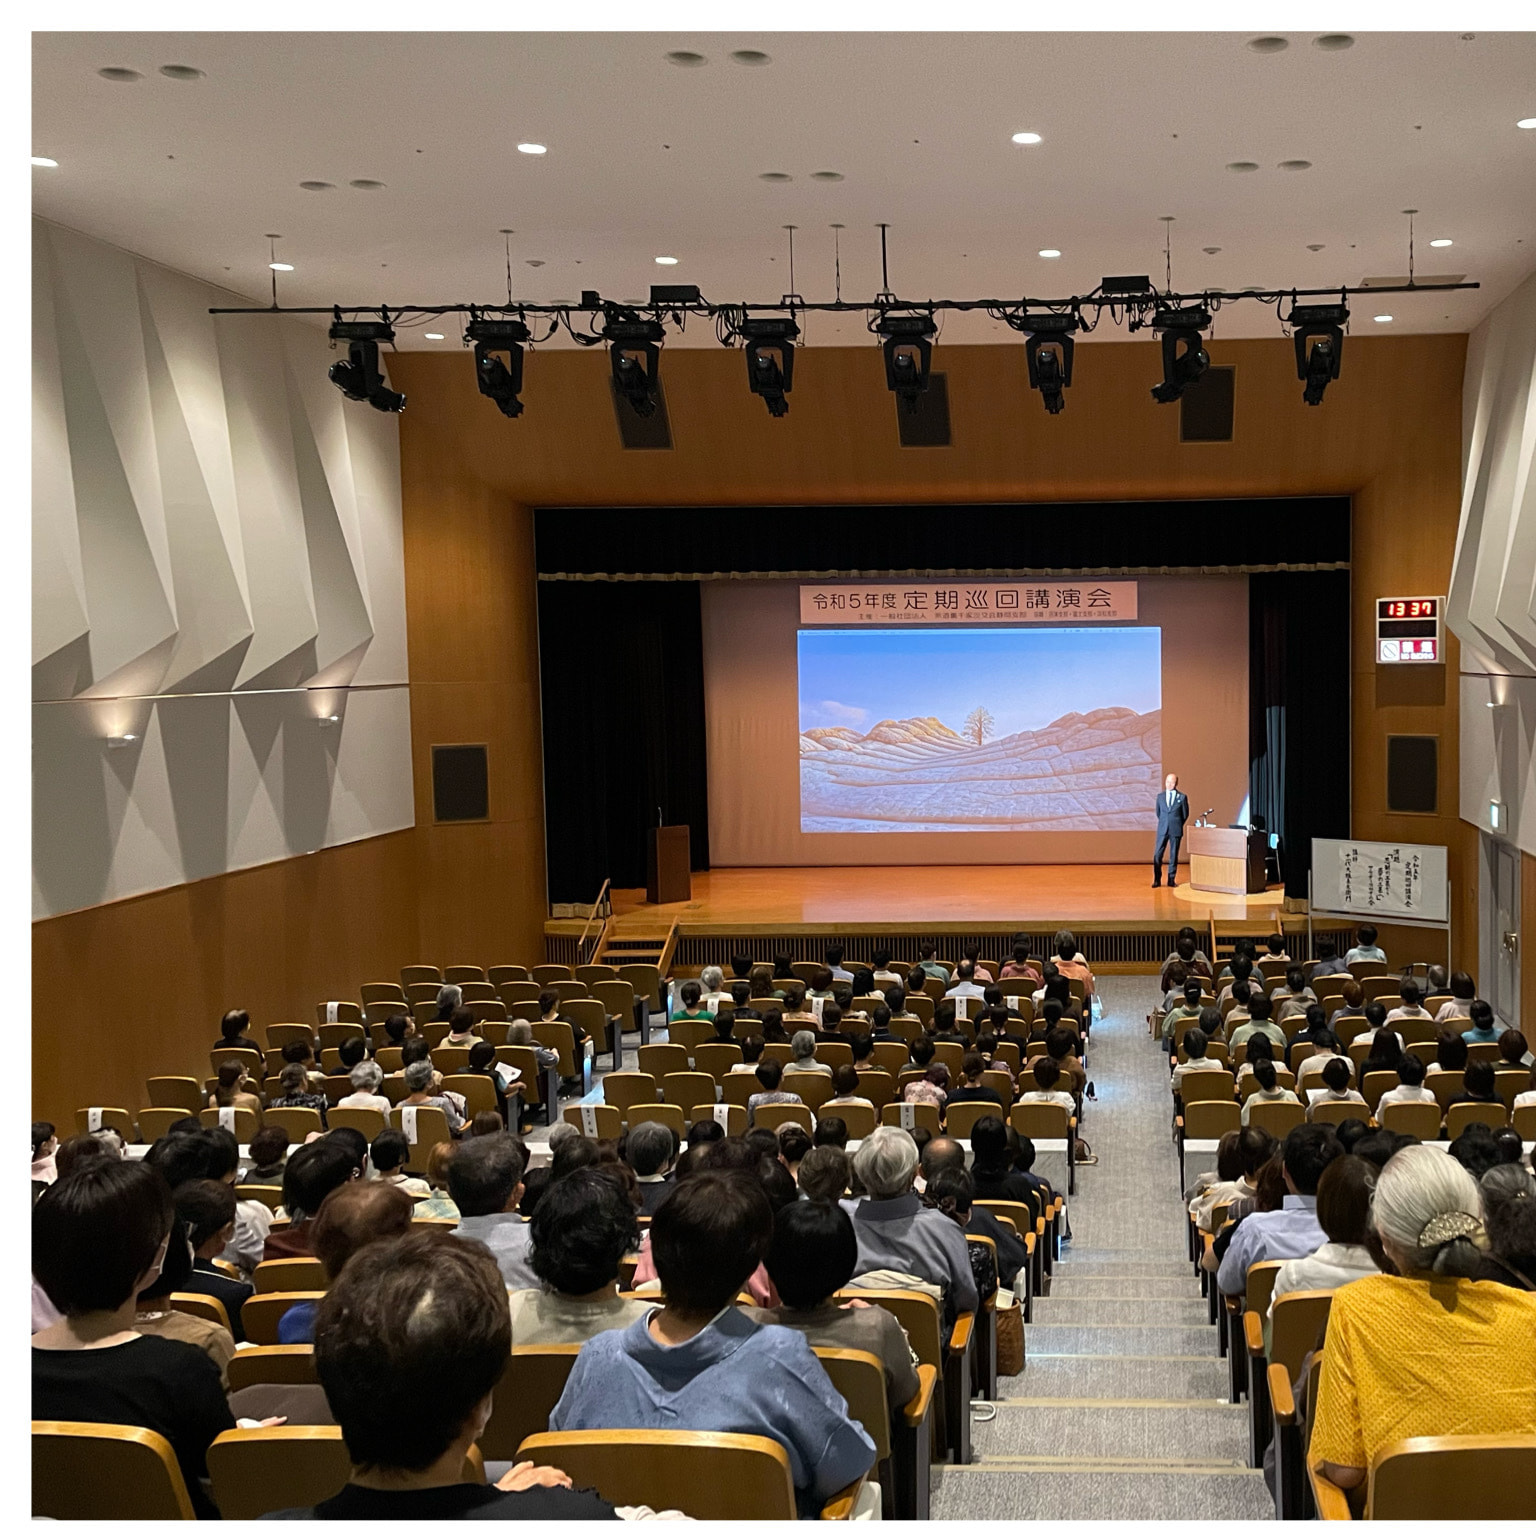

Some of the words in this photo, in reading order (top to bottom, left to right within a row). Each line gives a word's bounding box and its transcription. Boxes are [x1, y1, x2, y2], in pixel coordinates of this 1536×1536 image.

[813, 592, 897, 610] 令和5年度
[903, 588, 1112, 610] 定期巡回講演会
